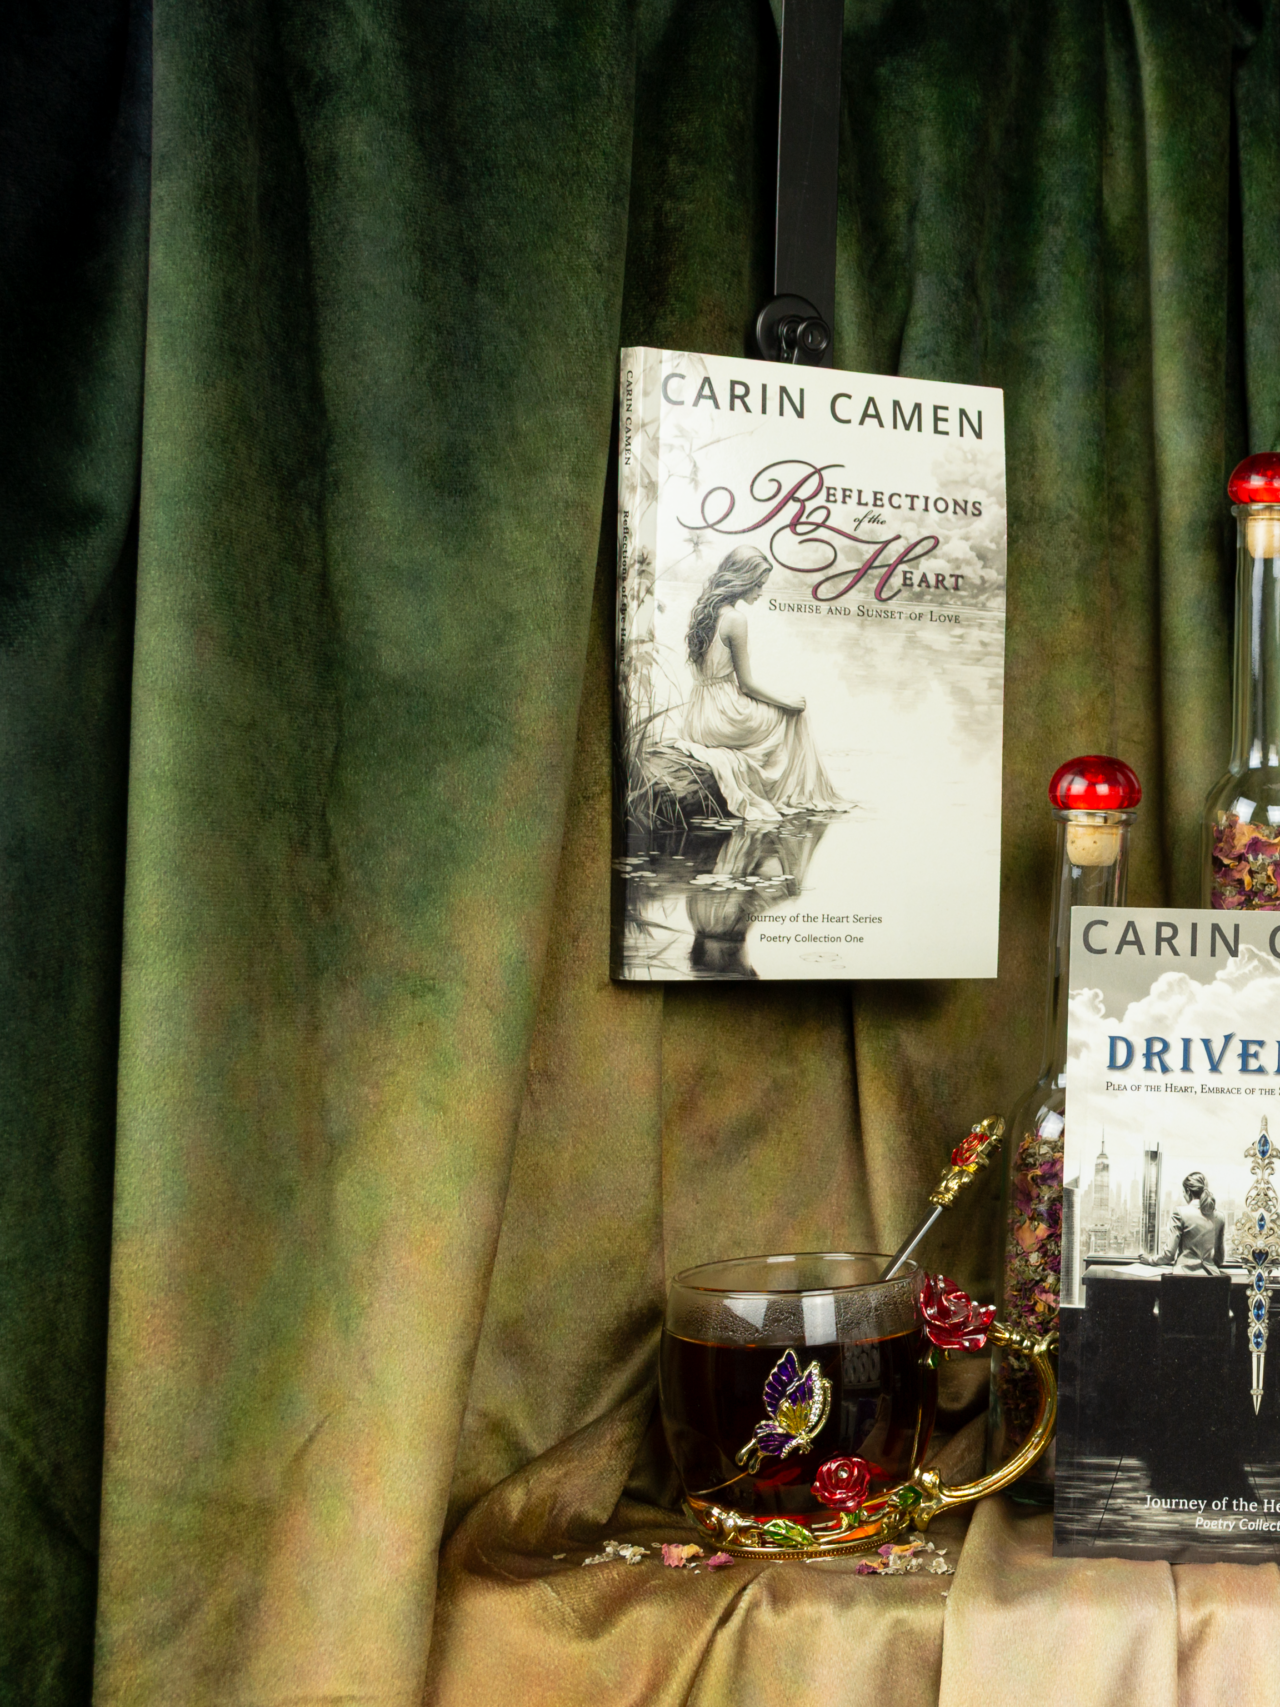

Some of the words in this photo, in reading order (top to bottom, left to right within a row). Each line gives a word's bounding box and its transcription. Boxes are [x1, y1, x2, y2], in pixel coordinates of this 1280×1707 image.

[625, 370, 634, 412] CARIN
[662, 372, 806, 419] CARIN
[829, 392, 983, 440] CAMEN
[624, 416, 633, 466] CAMEN
[853, 510, 873, 531] of
[621, 510, 630, 582] Reflections
[768, 598, 822, 614] SUNRISE
[826, 606, 851, 616] AND
[856, 604, 904, 620] SUNSET
[908, 611, 924, 622] OF
[929, 610, 961, 624] LOVE
[745, 912, 788, 926] Journey
[789, 913, 801, 923] of
[802, 913, 819, 923] the
[821, 913, 850, 924] Heart
[852, 914, 883, 924] Series
[760, 933, 791, 945] Poetry
[794, 933, 842, 944] Collection
[844, 934, 864, 944] One
[1082, 919, 1241, 958] CARIN
[1105, 1081, 1128, 1092] PLEA
[1200, 1083, 1242, 1095] EMBRACE
[1144, 1494, 1208, 1513] Journey
[1211, 1497, 1229, 1511] of
[1232, 1498, 1258, 1512] the
[1195, 1516, 1236, 1532] Poetry
